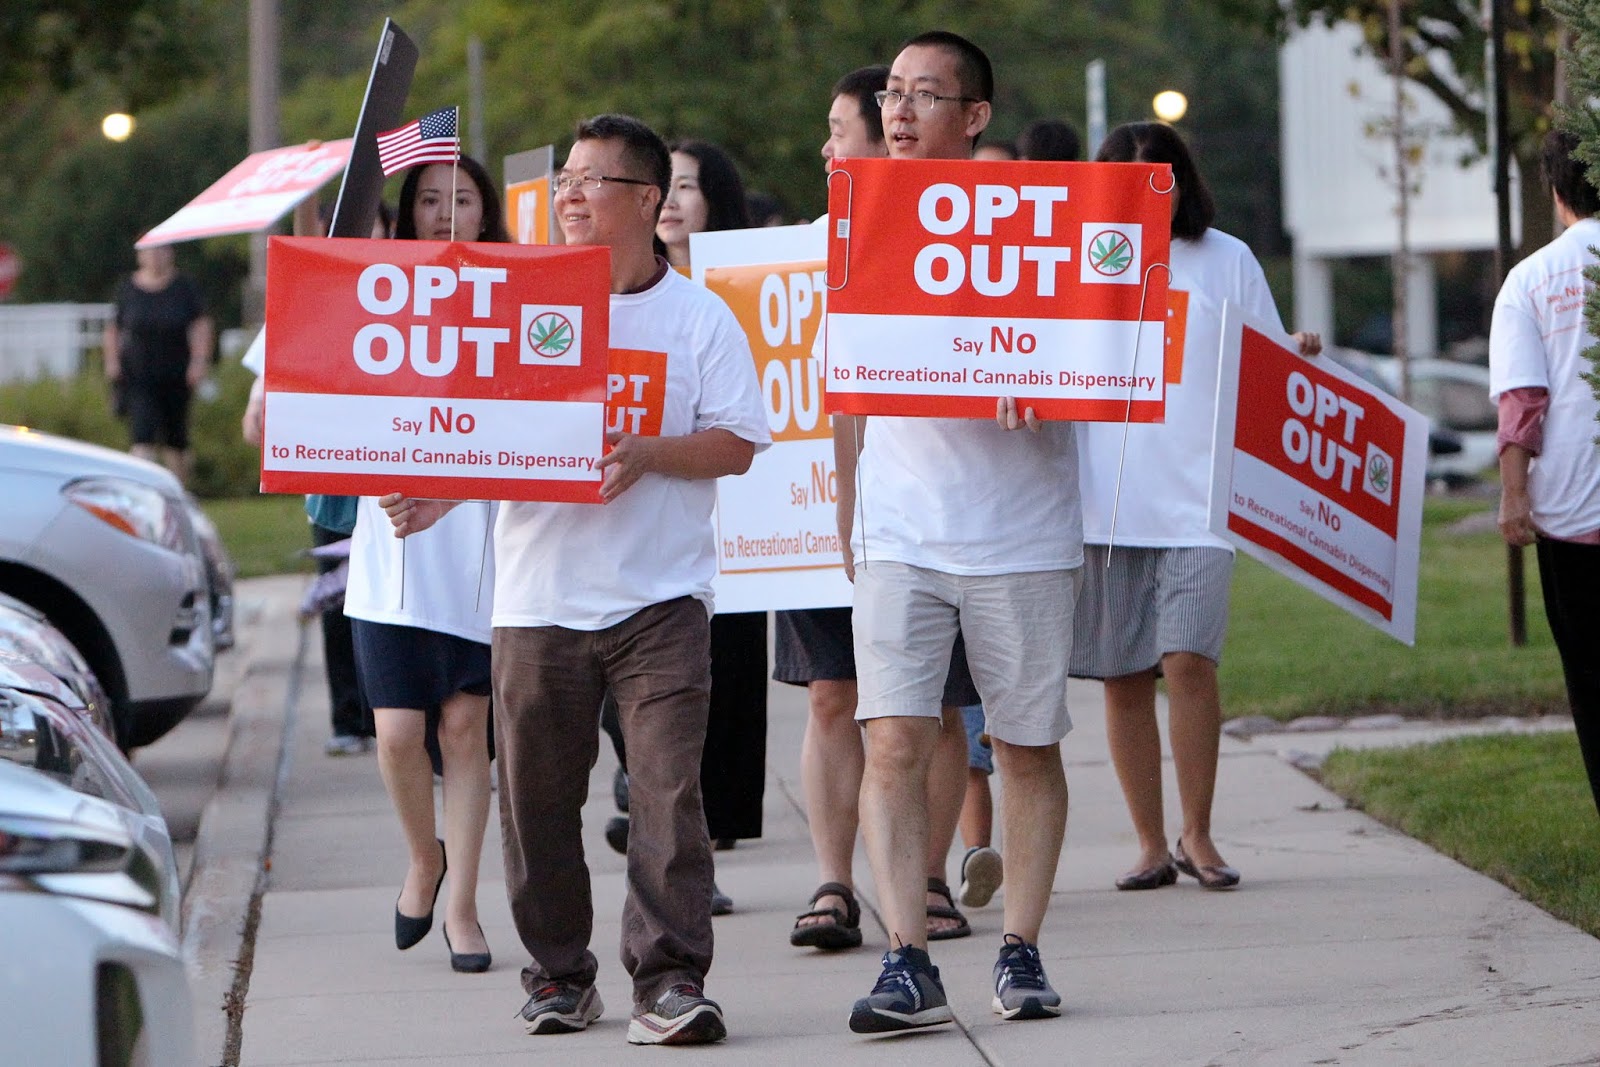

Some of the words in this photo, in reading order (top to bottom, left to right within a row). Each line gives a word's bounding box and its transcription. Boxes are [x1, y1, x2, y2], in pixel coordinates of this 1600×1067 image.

[918, 183, 1068, 237] OPT
[357, 263, 507, 318] OPT
[913, 243, 1071, 297] OUT
[353, 323, 510, 377] OUT
[953, 337, 984, 356] Say
[990, 326, 1037, 354] No
[606, 373, 650, 402] PT
[762, 358, 833, 433] OU
[833, 366, 850, 380] to
[856, 365, 967, 384] Recreational
[972, 368, 1053, 386] Cannabis
[1059, 371, 1156, 391] Dispensary
[392, 416, 422, 436] Say
[429, 406, 476, 434] No
[606, 406, 648, 434] UT
[1286, 371, 1364, 444] OPT
[271, 444, 290, 459] to
[295, 444, 406, 463] Recreational
[411, 448, 492, 466] Cannabis
[498, 451, 595, 472] Dispensary
[1282, 418, 1362, 493] OUT
[791, 482, 808, 510] Say
[811, 460, 838, 503] No
[1300, 500, 1315, 520] Say
[1318, 502, 1341, 532] No
[724, 538, 734, 558] to
[737, 530, 803, 558] Recreational
[1234, 492, 1245, 507] to
[1248, 498, 1307, 539] Recreational
[1308, 530, 1347, 564] Cannabis
[1348, 554, 1391, 593] Dispensary
